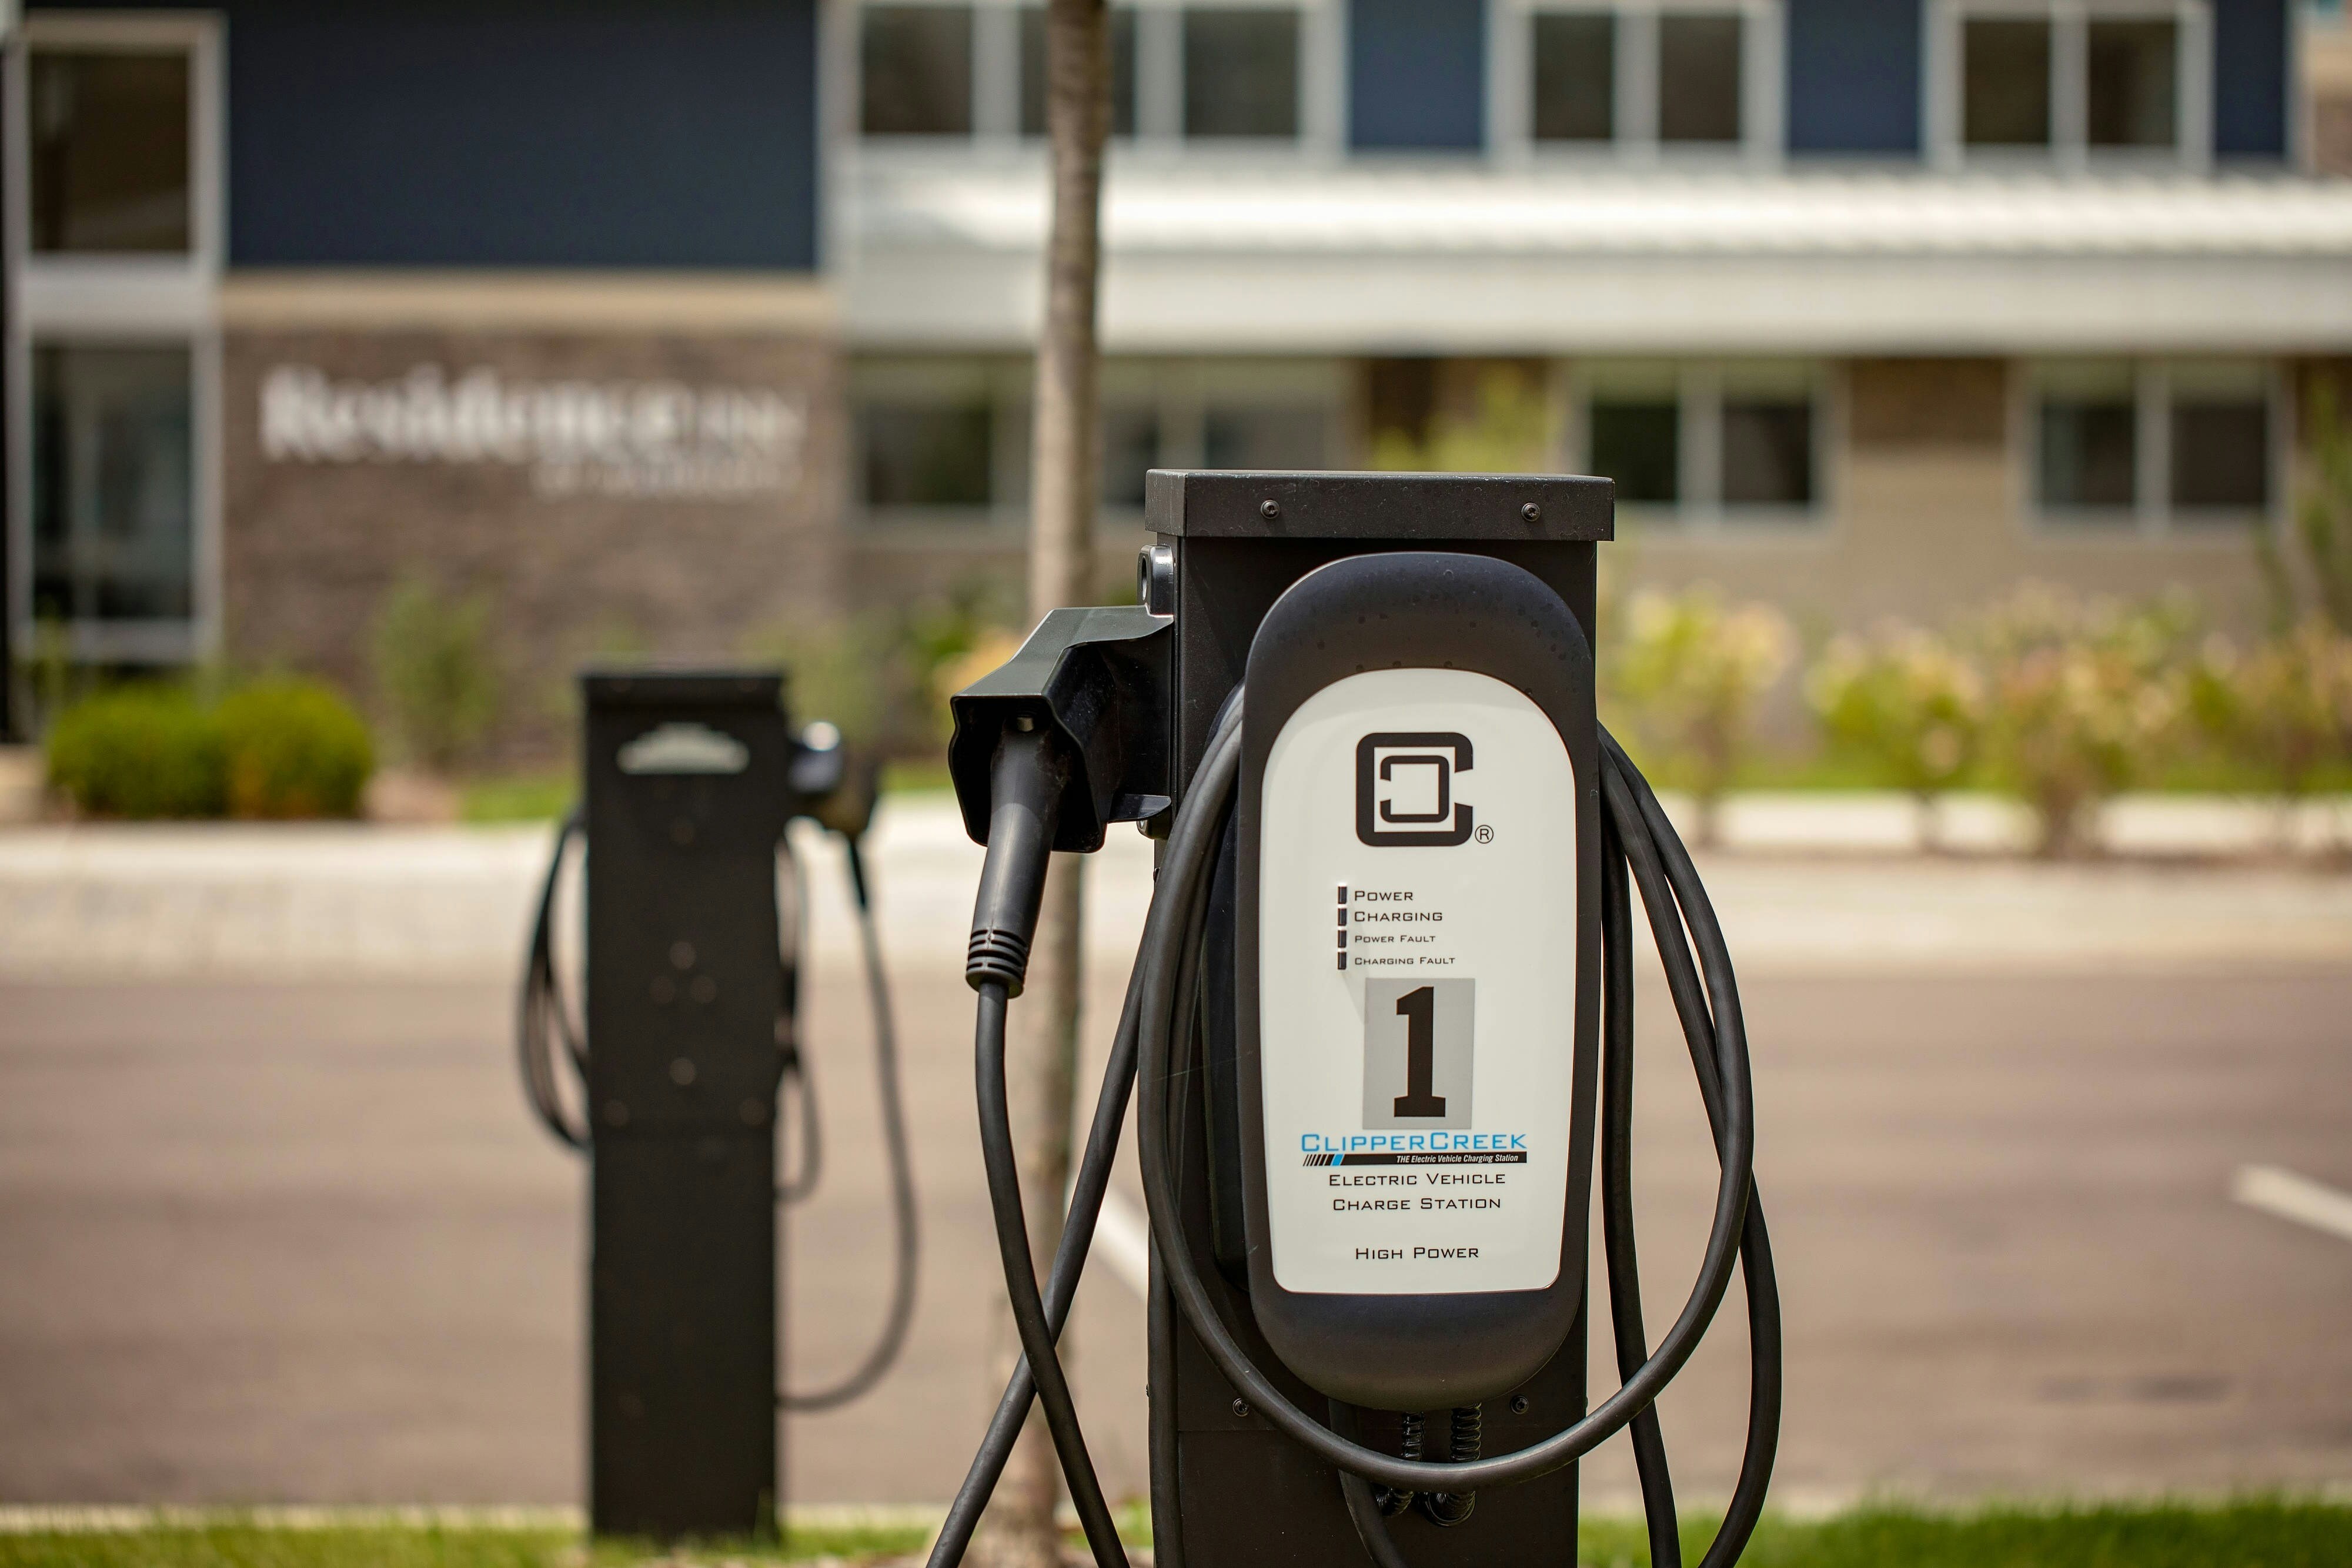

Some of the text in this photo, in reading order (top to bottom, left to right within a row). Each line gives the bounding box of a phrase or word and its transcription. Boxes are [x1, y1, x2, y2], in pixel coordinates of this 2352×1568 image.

[1355, 891, 1413, 901] POWER
[1354, 911, 1442, 922] CHARGING
[1394, 987, 1445, 1117] 1
[1396, 1155, 1409, 1163] THE
[1411, 1155, 1436, 1163] Electric
[1463, 1154, 1493, 1164] Charging
[1329, 1174, 1505, 1186] ELECTRIC VEHICLE
[1334, 1198, 1500, 1211] CHARGE STATION
[1356, 1247, 1478, 1259] HIGH POWER
